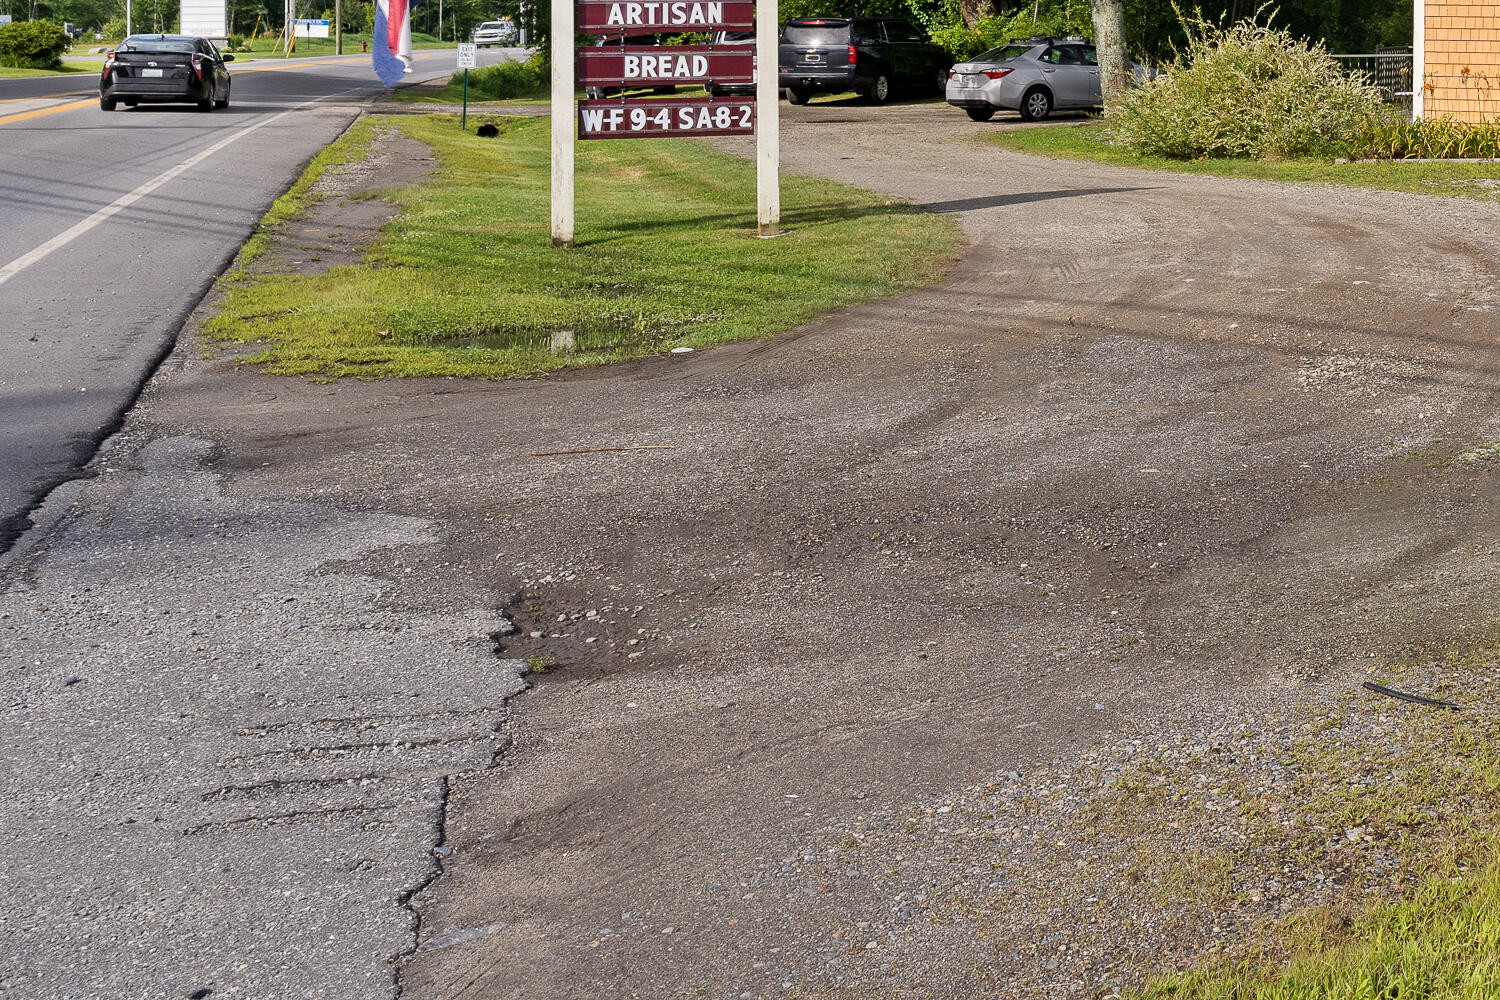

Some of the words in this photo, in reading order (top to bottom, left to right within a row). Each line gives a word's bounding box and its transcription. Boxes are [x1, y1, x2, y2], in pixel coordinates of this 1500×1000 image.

[607, 2, 722, 25] ARTISAN
[624, 56, 708, 78] BREAD
[582, 109, 624, 132] W-F
[630, 108, 671, 131] 9-4
